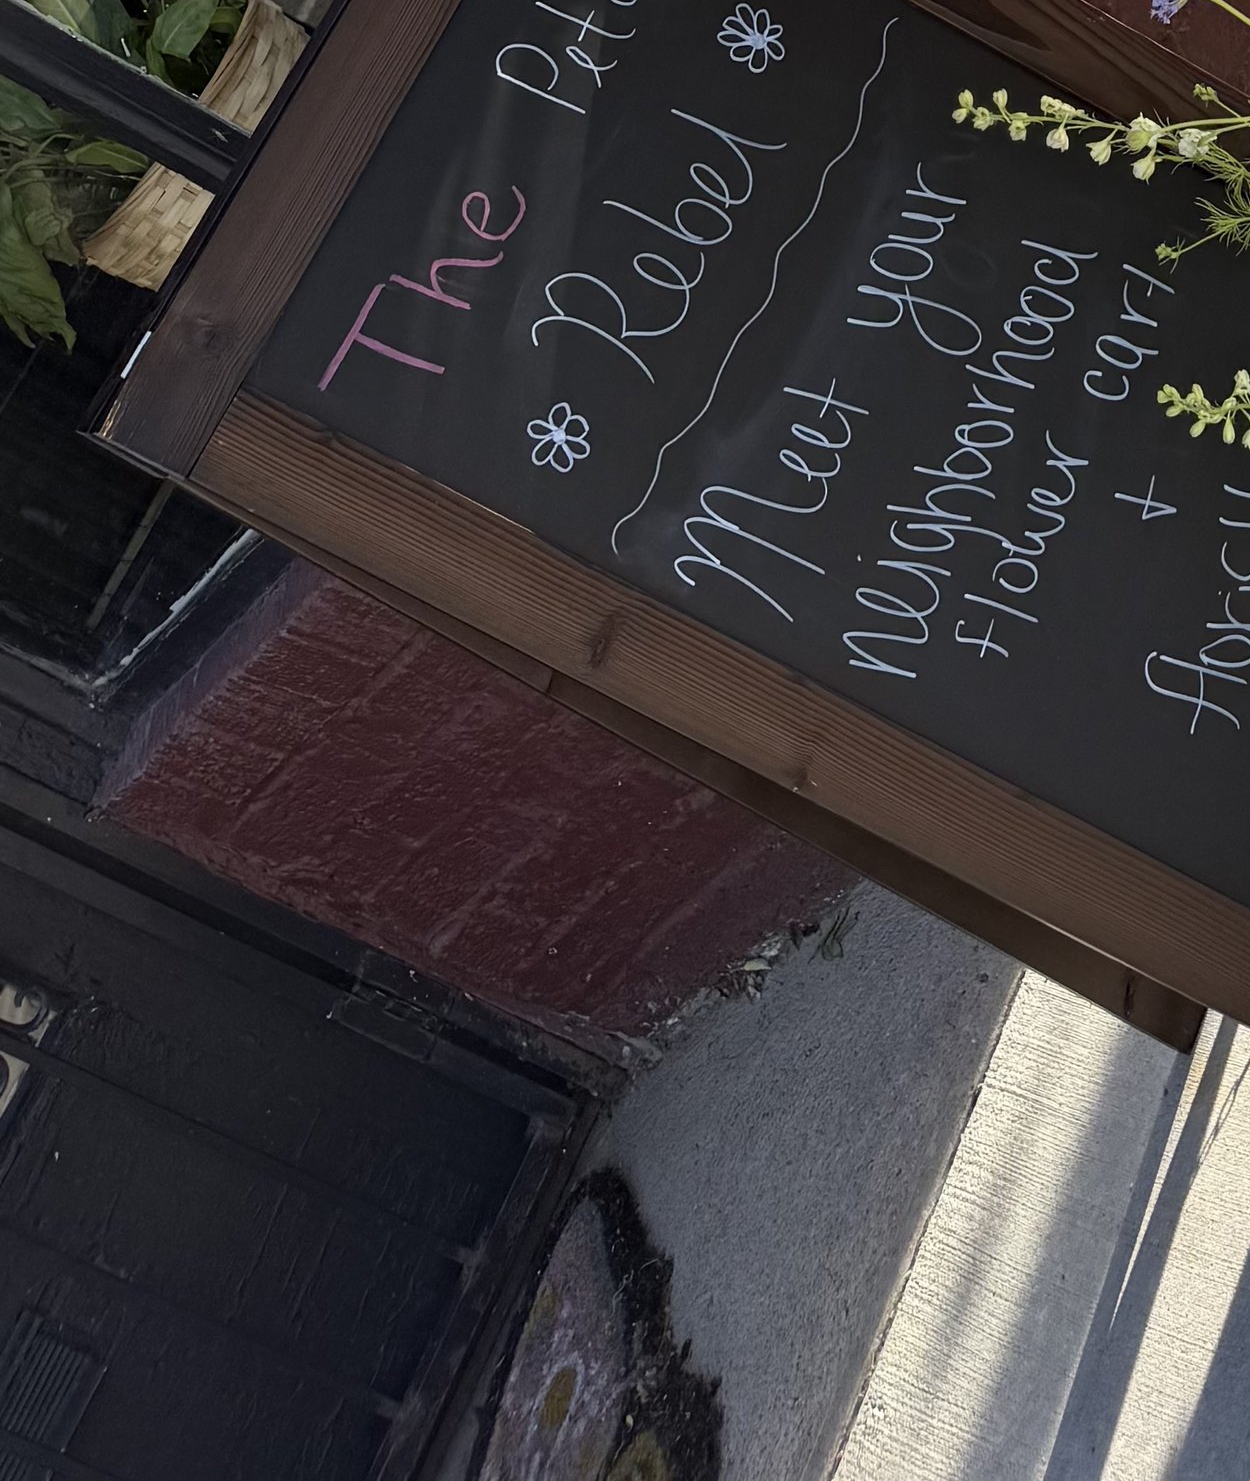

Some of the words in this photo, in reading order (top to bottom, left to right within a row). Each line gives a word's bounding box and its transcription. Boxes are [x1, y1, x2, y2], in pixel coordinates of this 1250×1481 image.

[320, 184, 527, 392] The
[531, 108, 788, 384] Rebel
[673, 377, 870, 623] Meet
[847, 162, 982, 356] your
[842, 239, 1099, 678] neighborhood
[955, 429, 1089, 658] flower
[1083, 262, 1176, 402] cart
